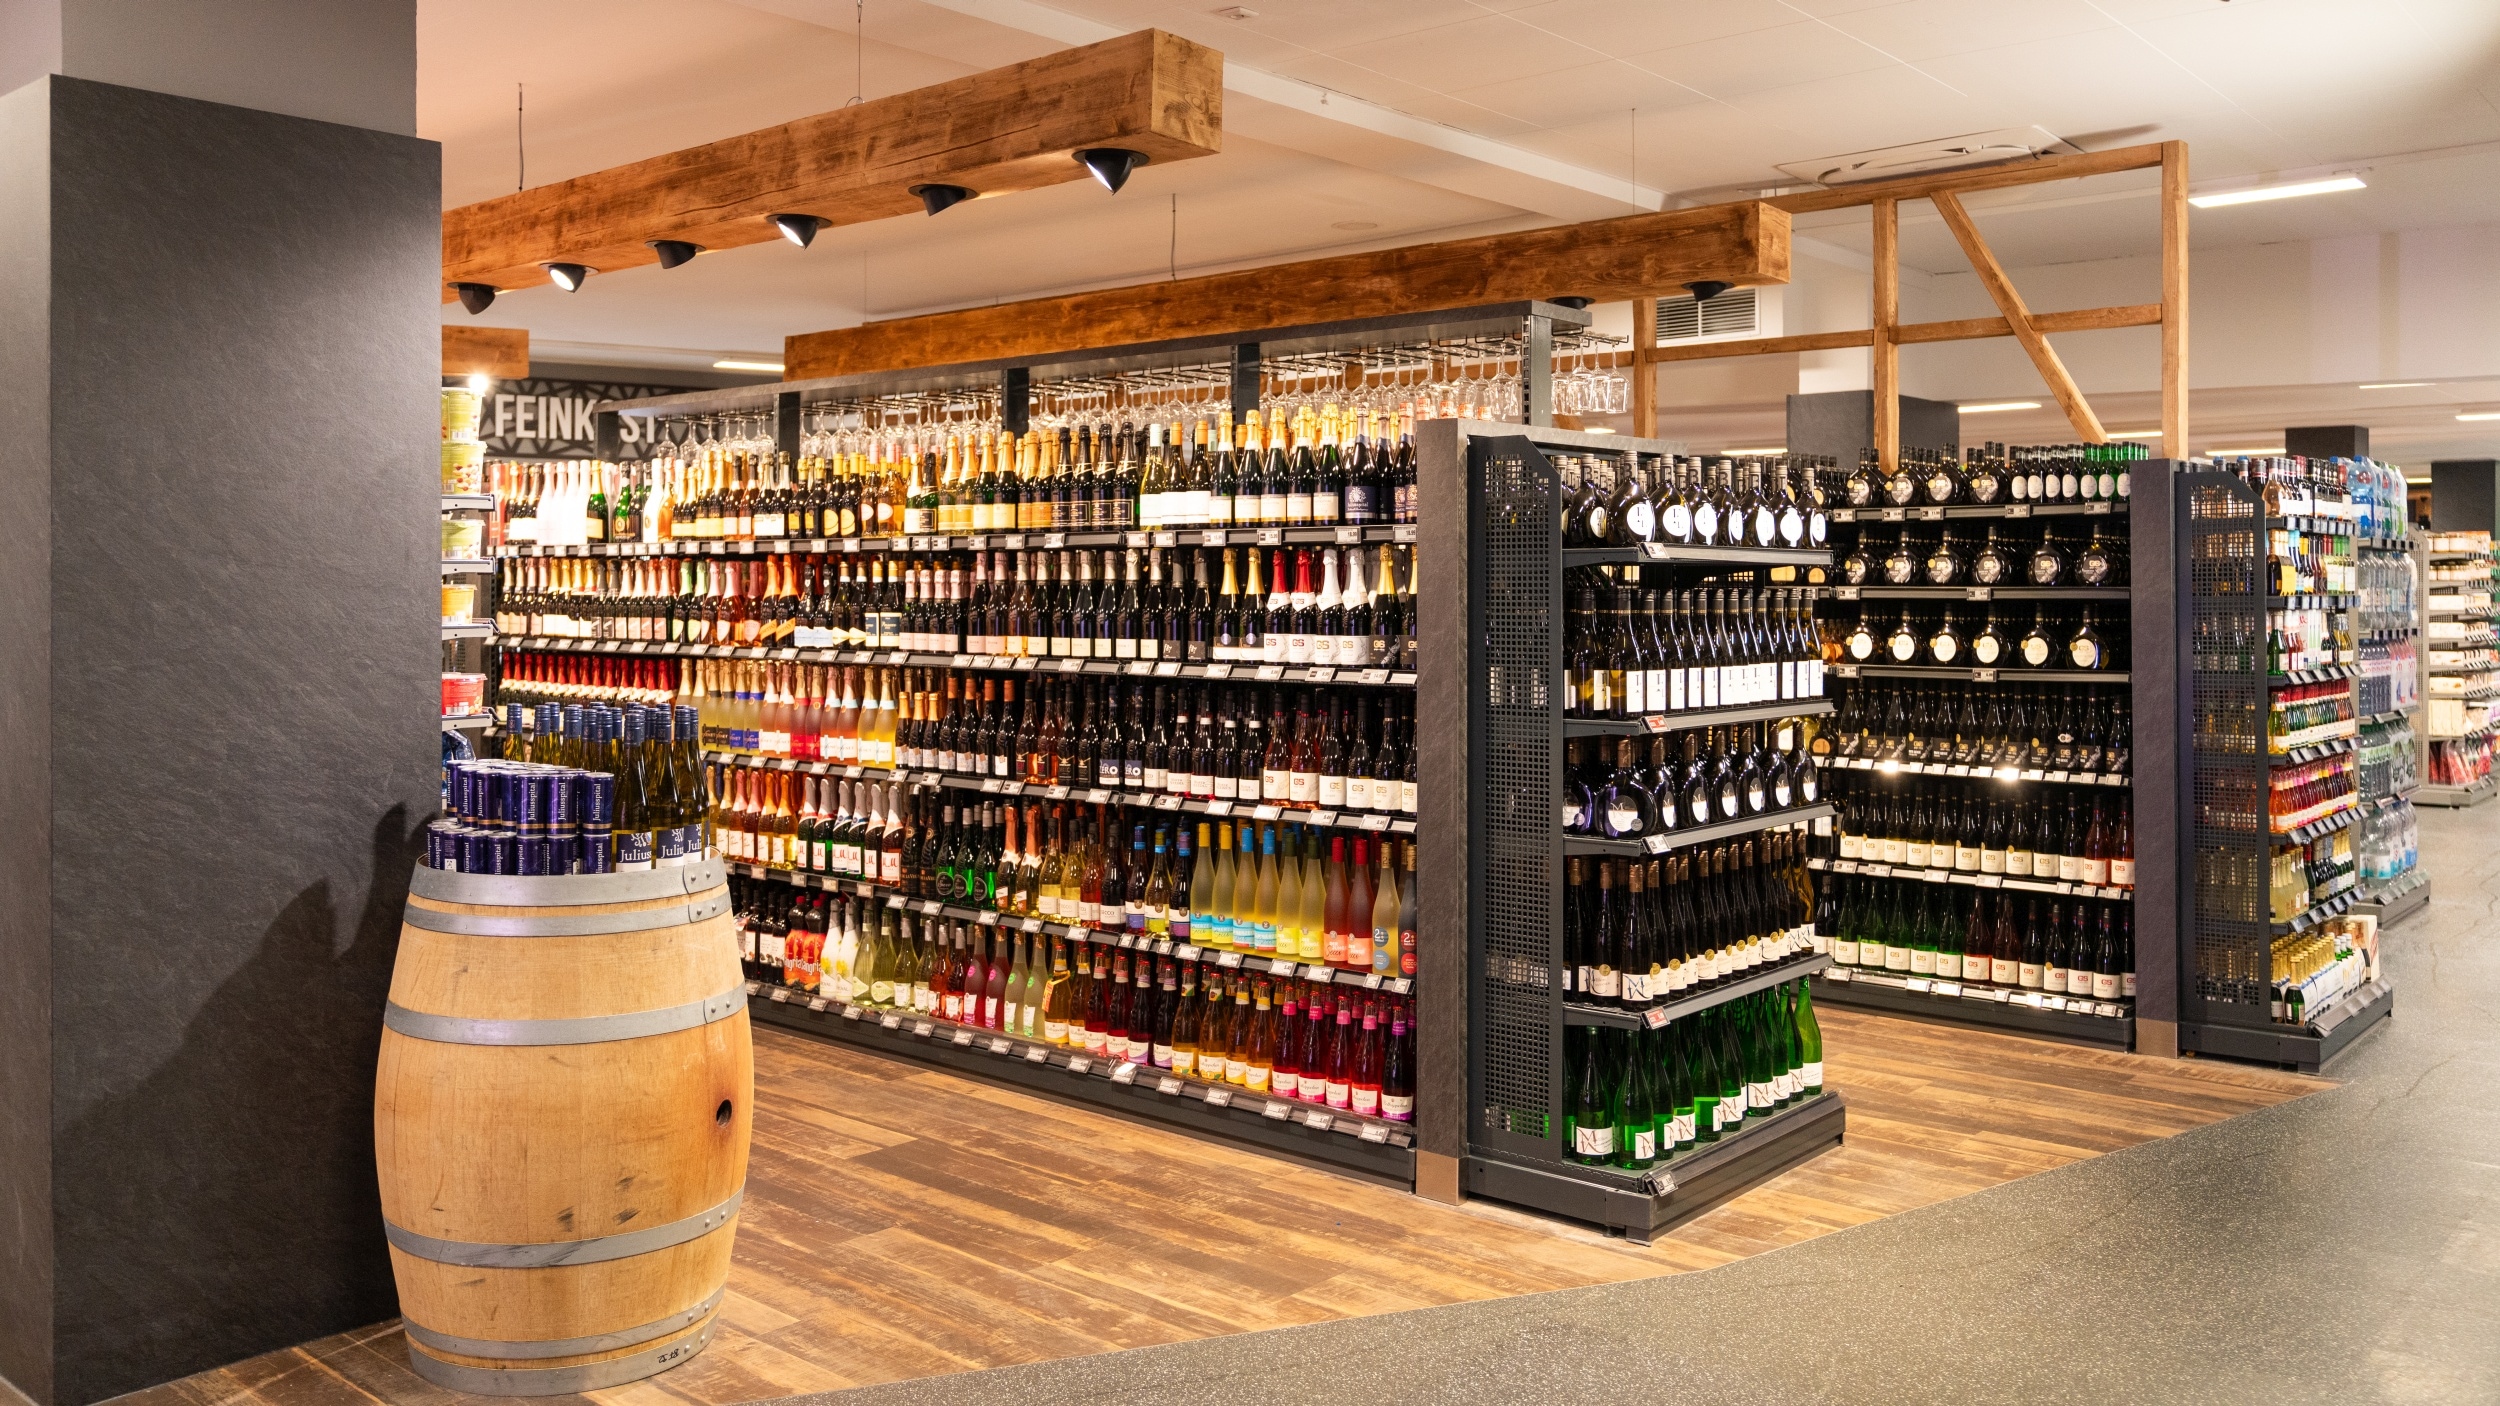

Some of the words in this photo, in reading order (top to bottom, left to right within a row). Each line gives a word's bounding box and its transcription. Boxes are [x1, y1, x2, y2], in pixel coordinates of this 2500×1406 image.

[495, 394, 656, 443] FEINKST
[1266, 638, 1276, 646] GS
[1293, 639, 1304, 647] GS
[1317, 640, 1329, 649] GS
[1352, 784, 1363, 792] GS
[528, 782, 537, 820] Juliusspital
[558, 782, 567, 820] Juliusspital
[593, 783, 602, 821] Juliusspital
[1374, 929, 1380, 938] 2
[1404, 933, 1410, 942] 2
